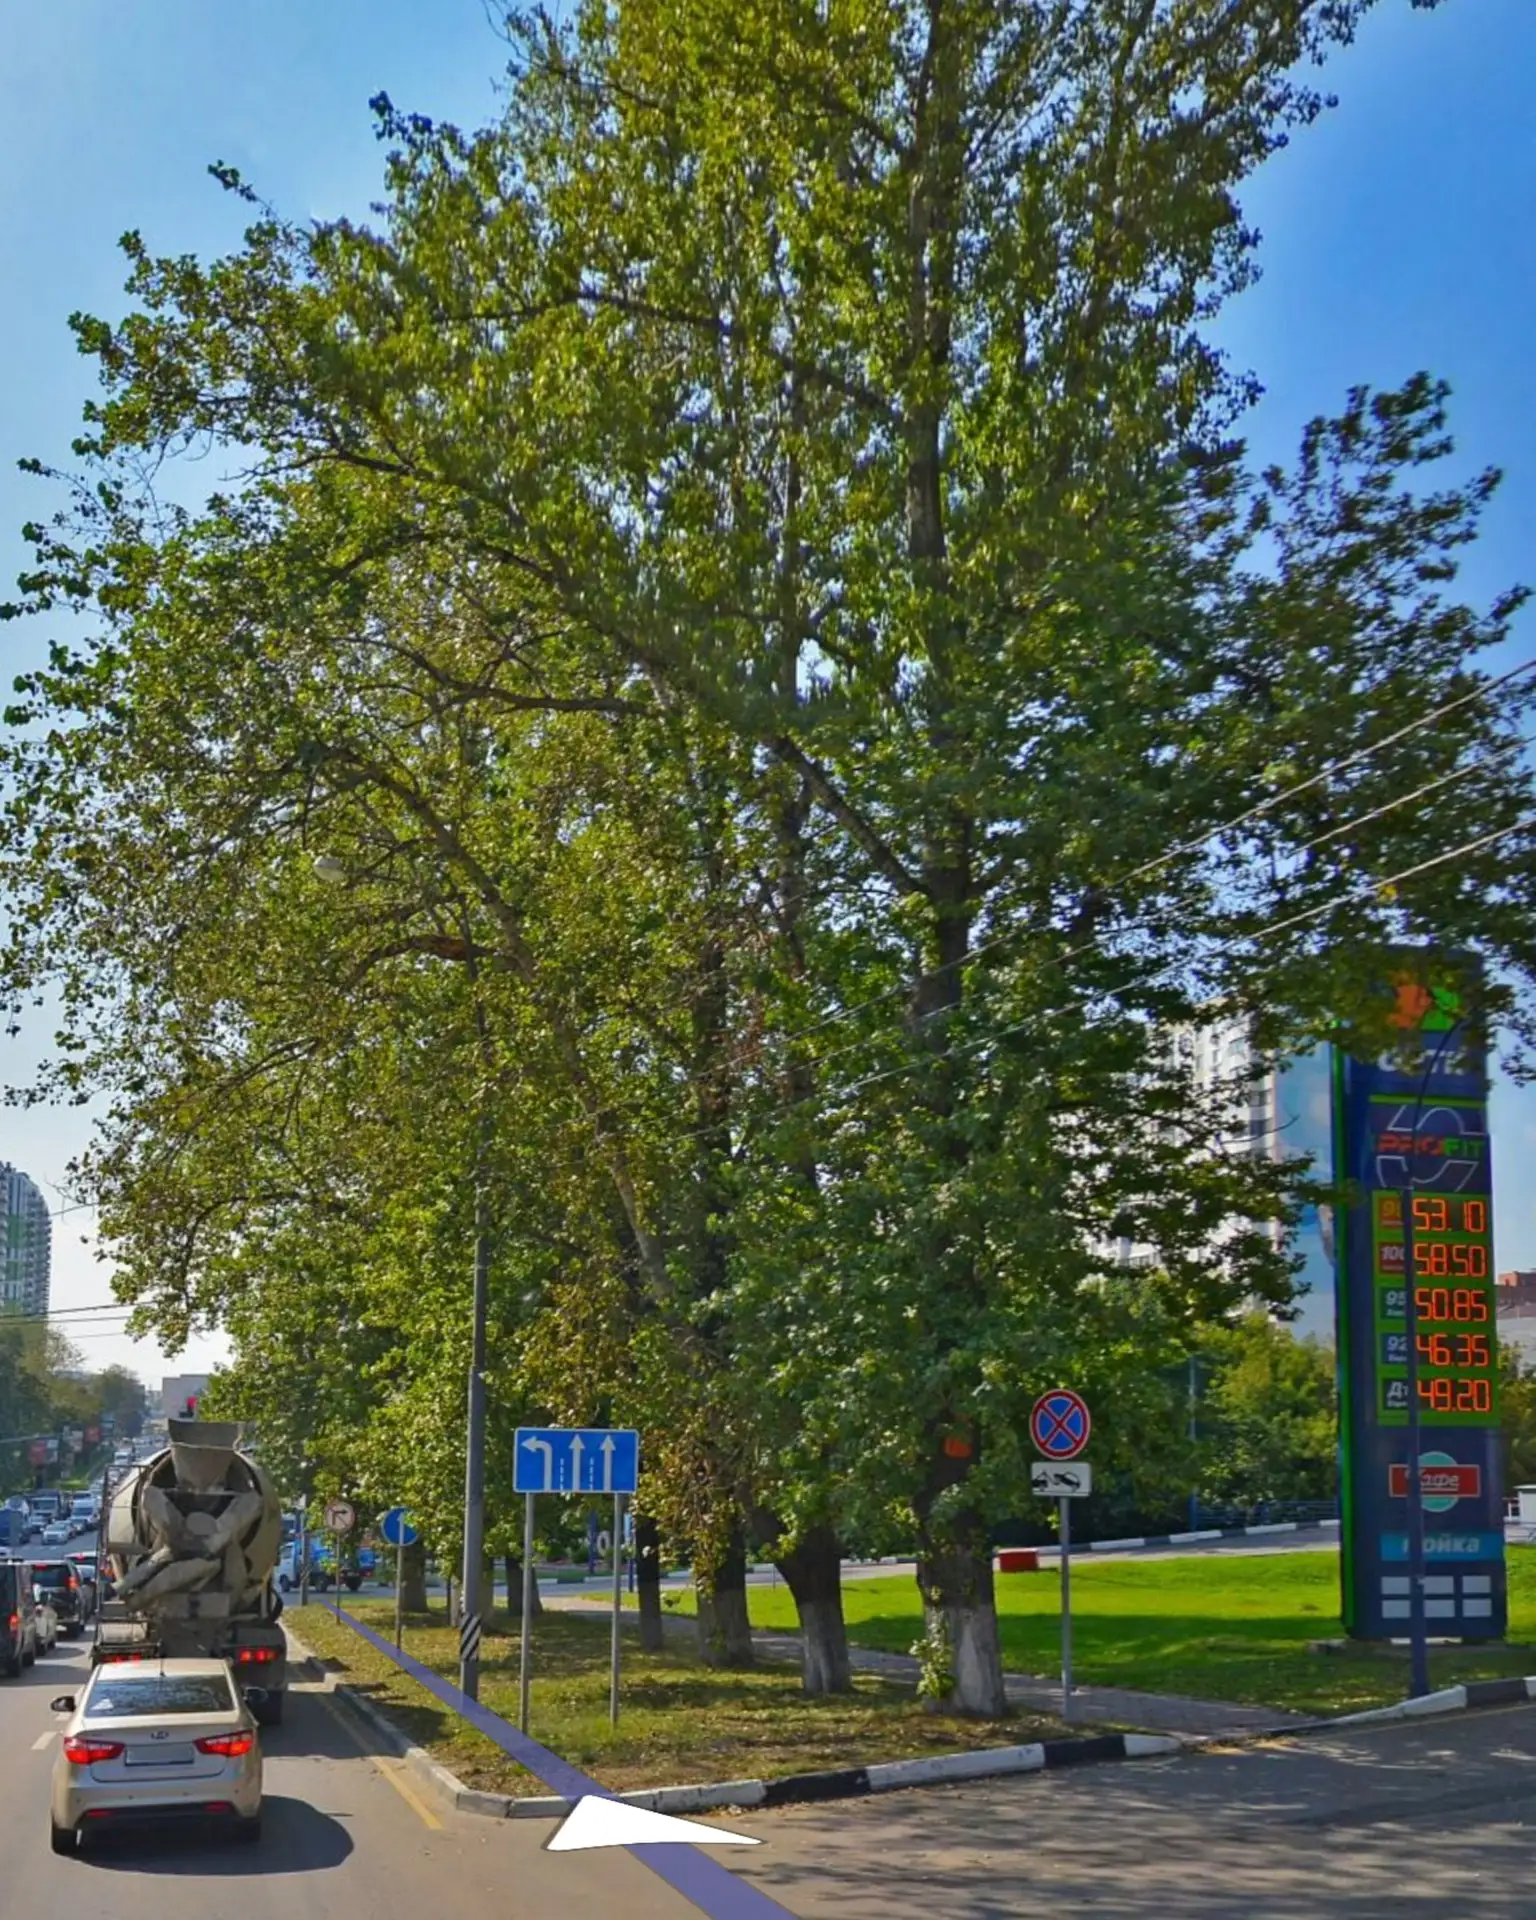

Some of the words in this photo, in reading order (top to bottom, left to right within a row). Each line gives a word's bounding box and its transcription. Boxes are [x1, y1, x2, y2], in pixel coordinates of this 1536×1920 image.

[1412, 1198, 1485, 1233] 53.10
[1414, 1243, 1486, 1277] 58.50
[1415, 1288, 1488, 1322] 50.85
[1416, 1333, 1489, 1367] 46.35
[1417, 1378, 1490, 1412] 49.20
[1403, 1532, 1480, 1553] ойка
